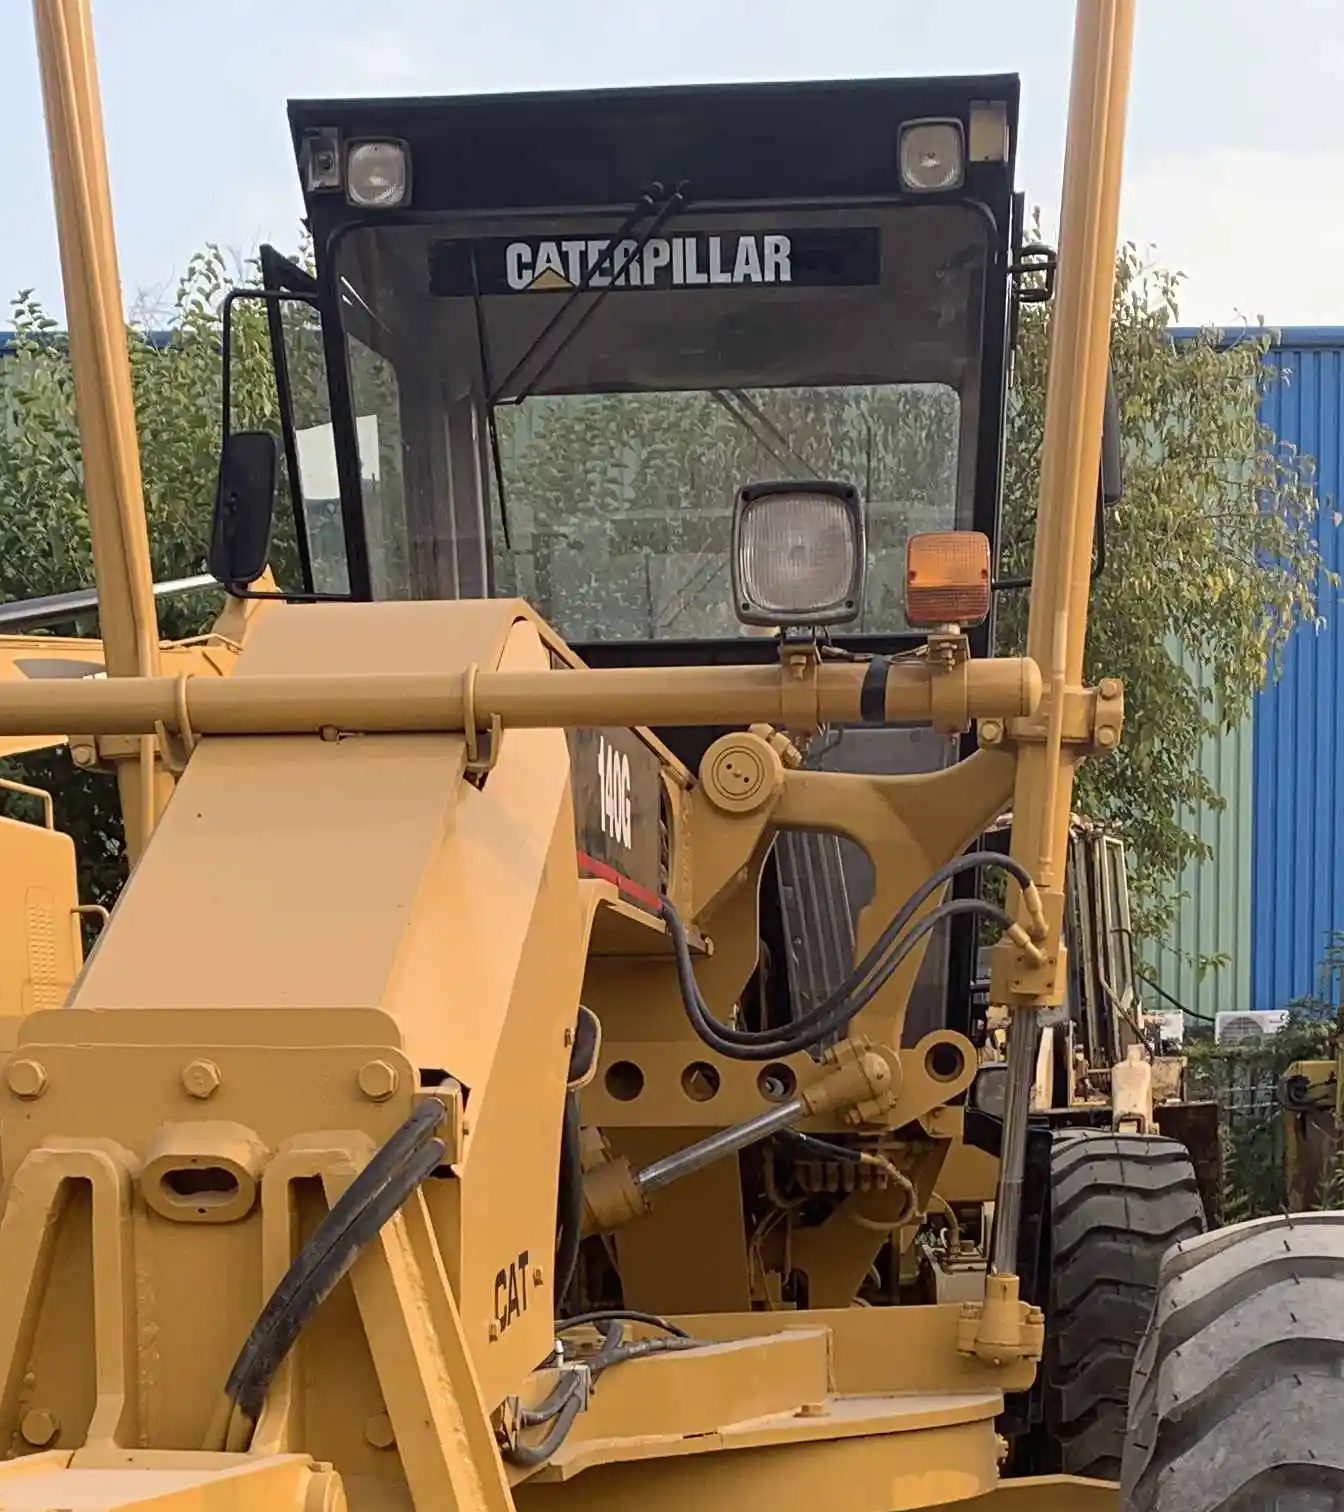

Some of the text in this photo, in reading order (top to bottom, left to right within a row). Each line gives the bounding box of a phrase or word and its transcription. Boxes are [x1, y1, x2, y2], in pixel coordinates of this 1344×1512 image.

[506, 235, 793, 290] CATERPILLAR
[598, 735, 631, 850] 140G
[494, 1250, 529, 1334] CAT
